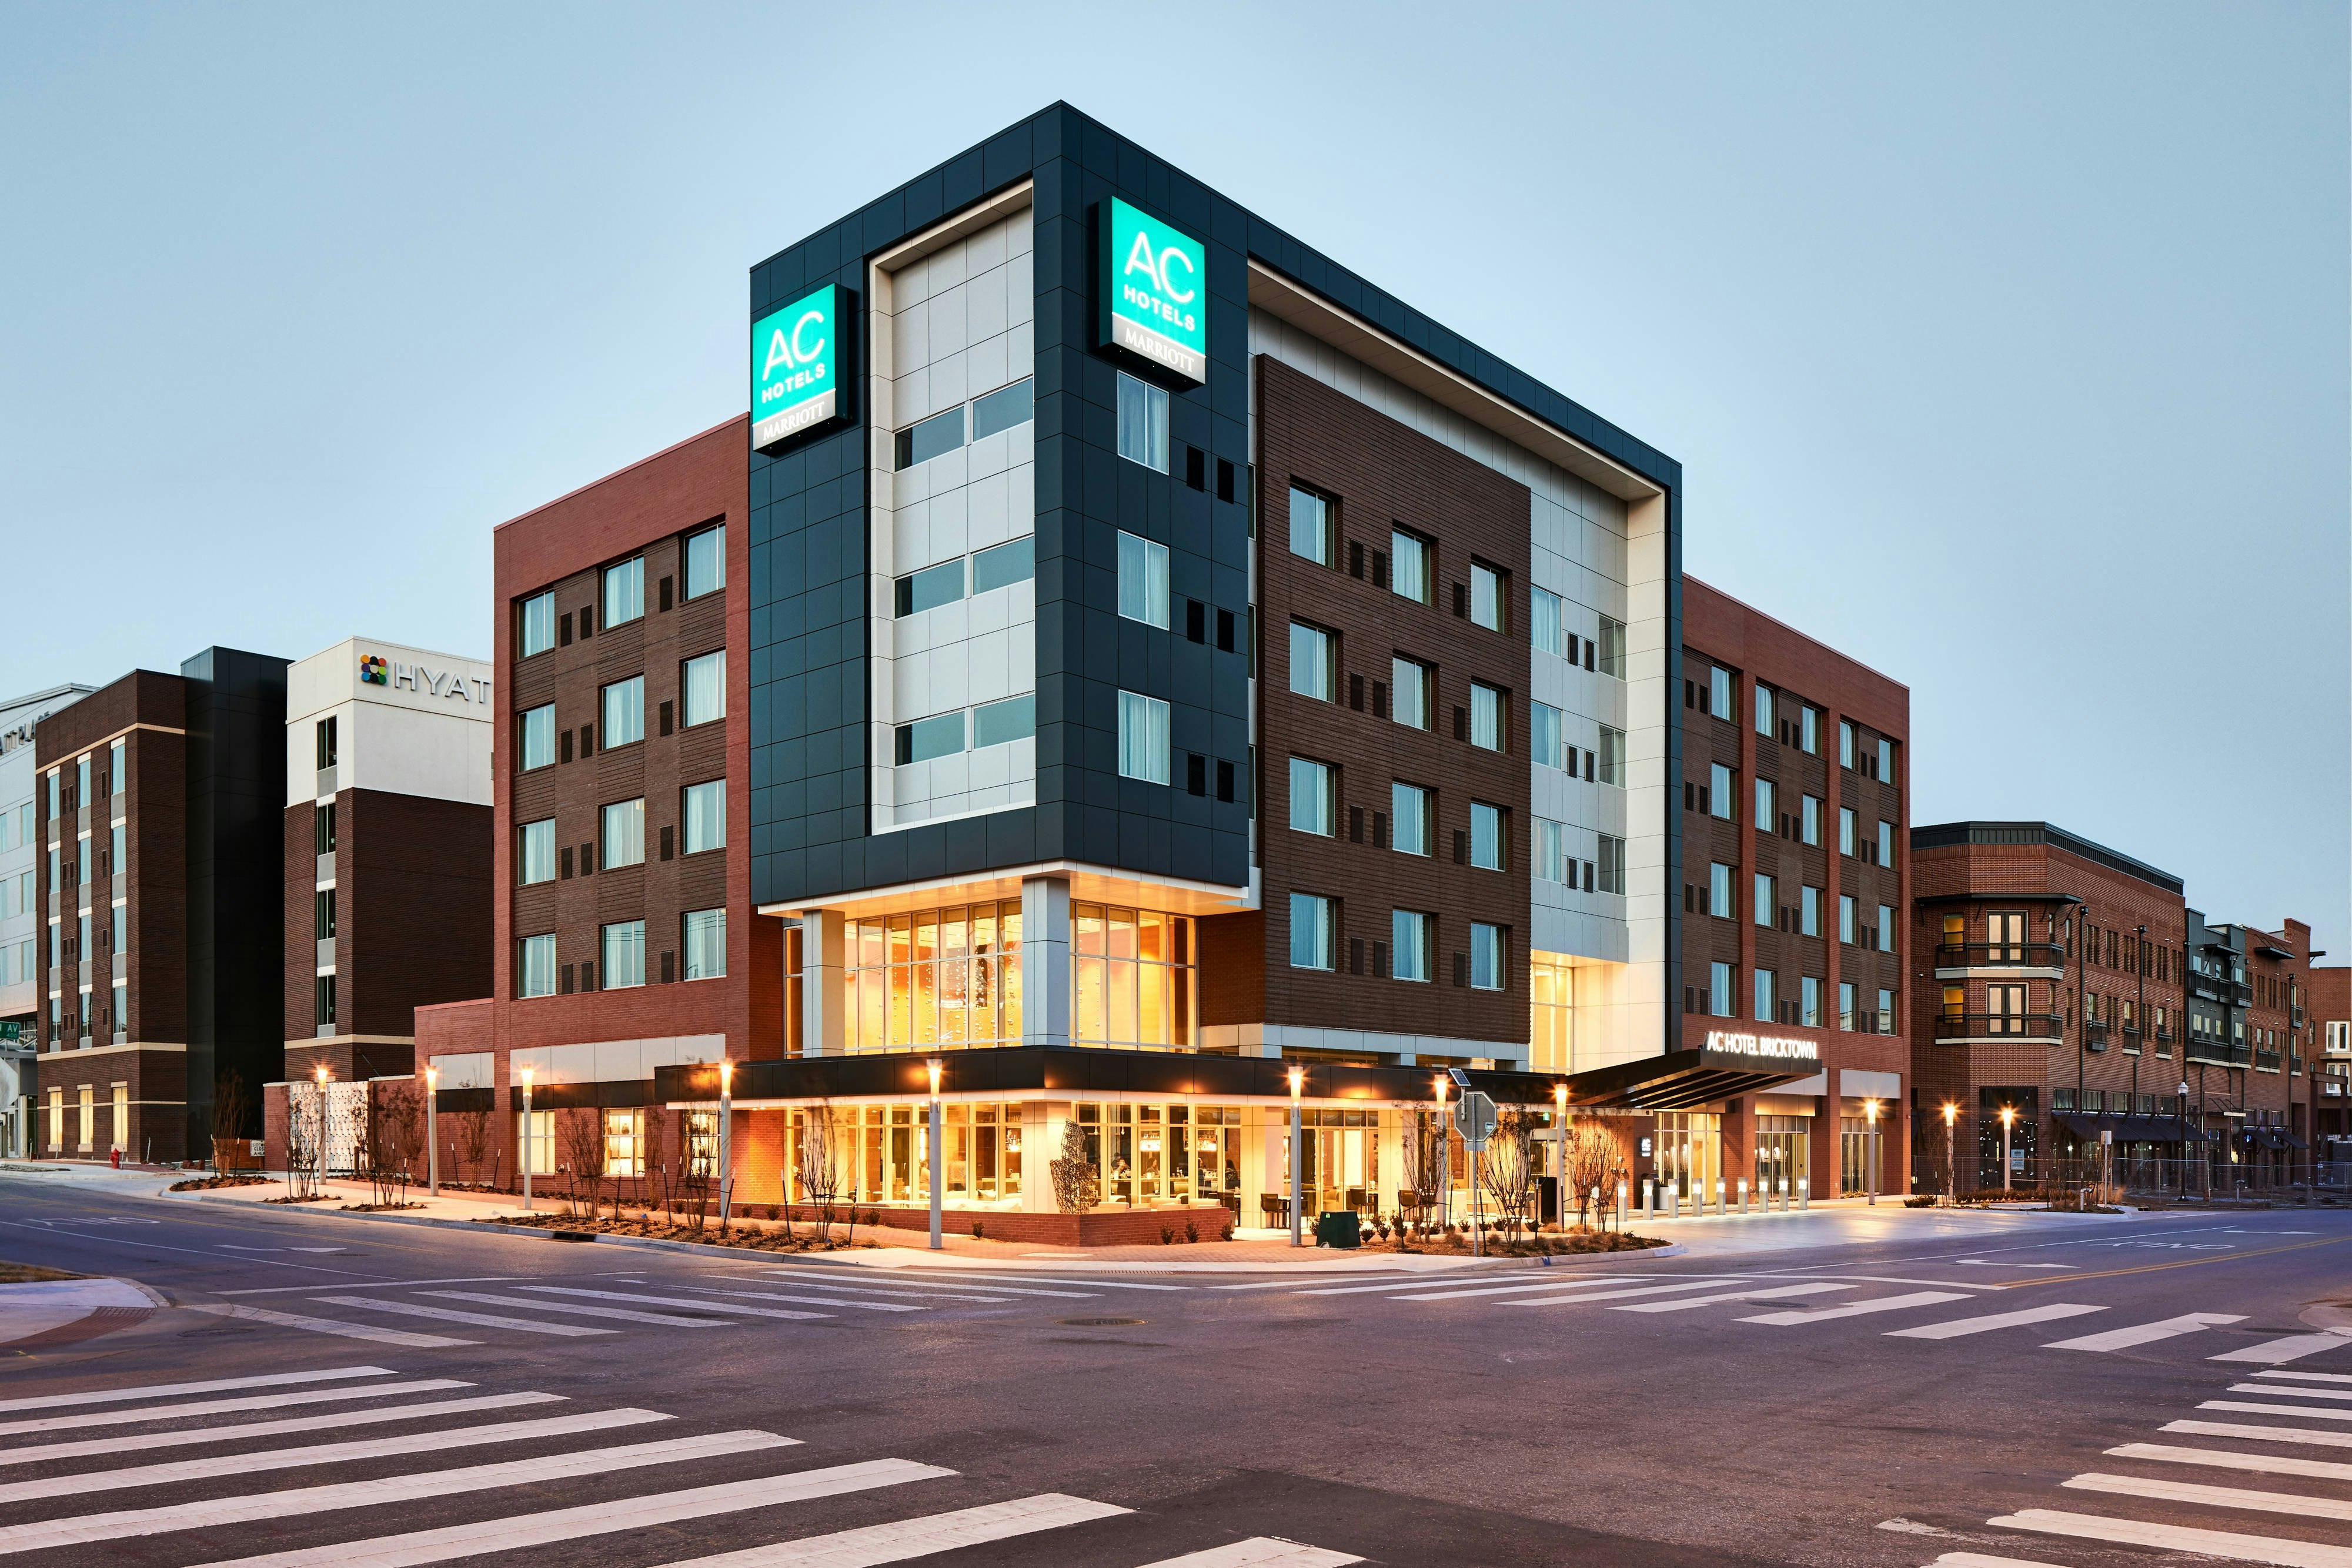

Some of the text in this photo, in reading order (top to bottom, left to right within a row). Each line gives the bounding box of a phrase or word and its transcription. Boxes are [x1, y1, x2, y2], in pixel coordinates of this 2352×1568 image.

[1124, 232, 1194, 303] AC
[1124, 284, 1195, 331] HOTELS
[762, 310, 824, 381] AC
[1125, 327, 1194, 372] MARRIOTT
[761, 363, 826, 403] HOTELS
[763, 402, 824, 441] MARRIOTT
[7, 1024, 18, 1032] AV
[1707, 1031, 1816, 1059] AC HOTEL BRICKTOWN
[2088, 1242, 2236, 1250] ONLY
